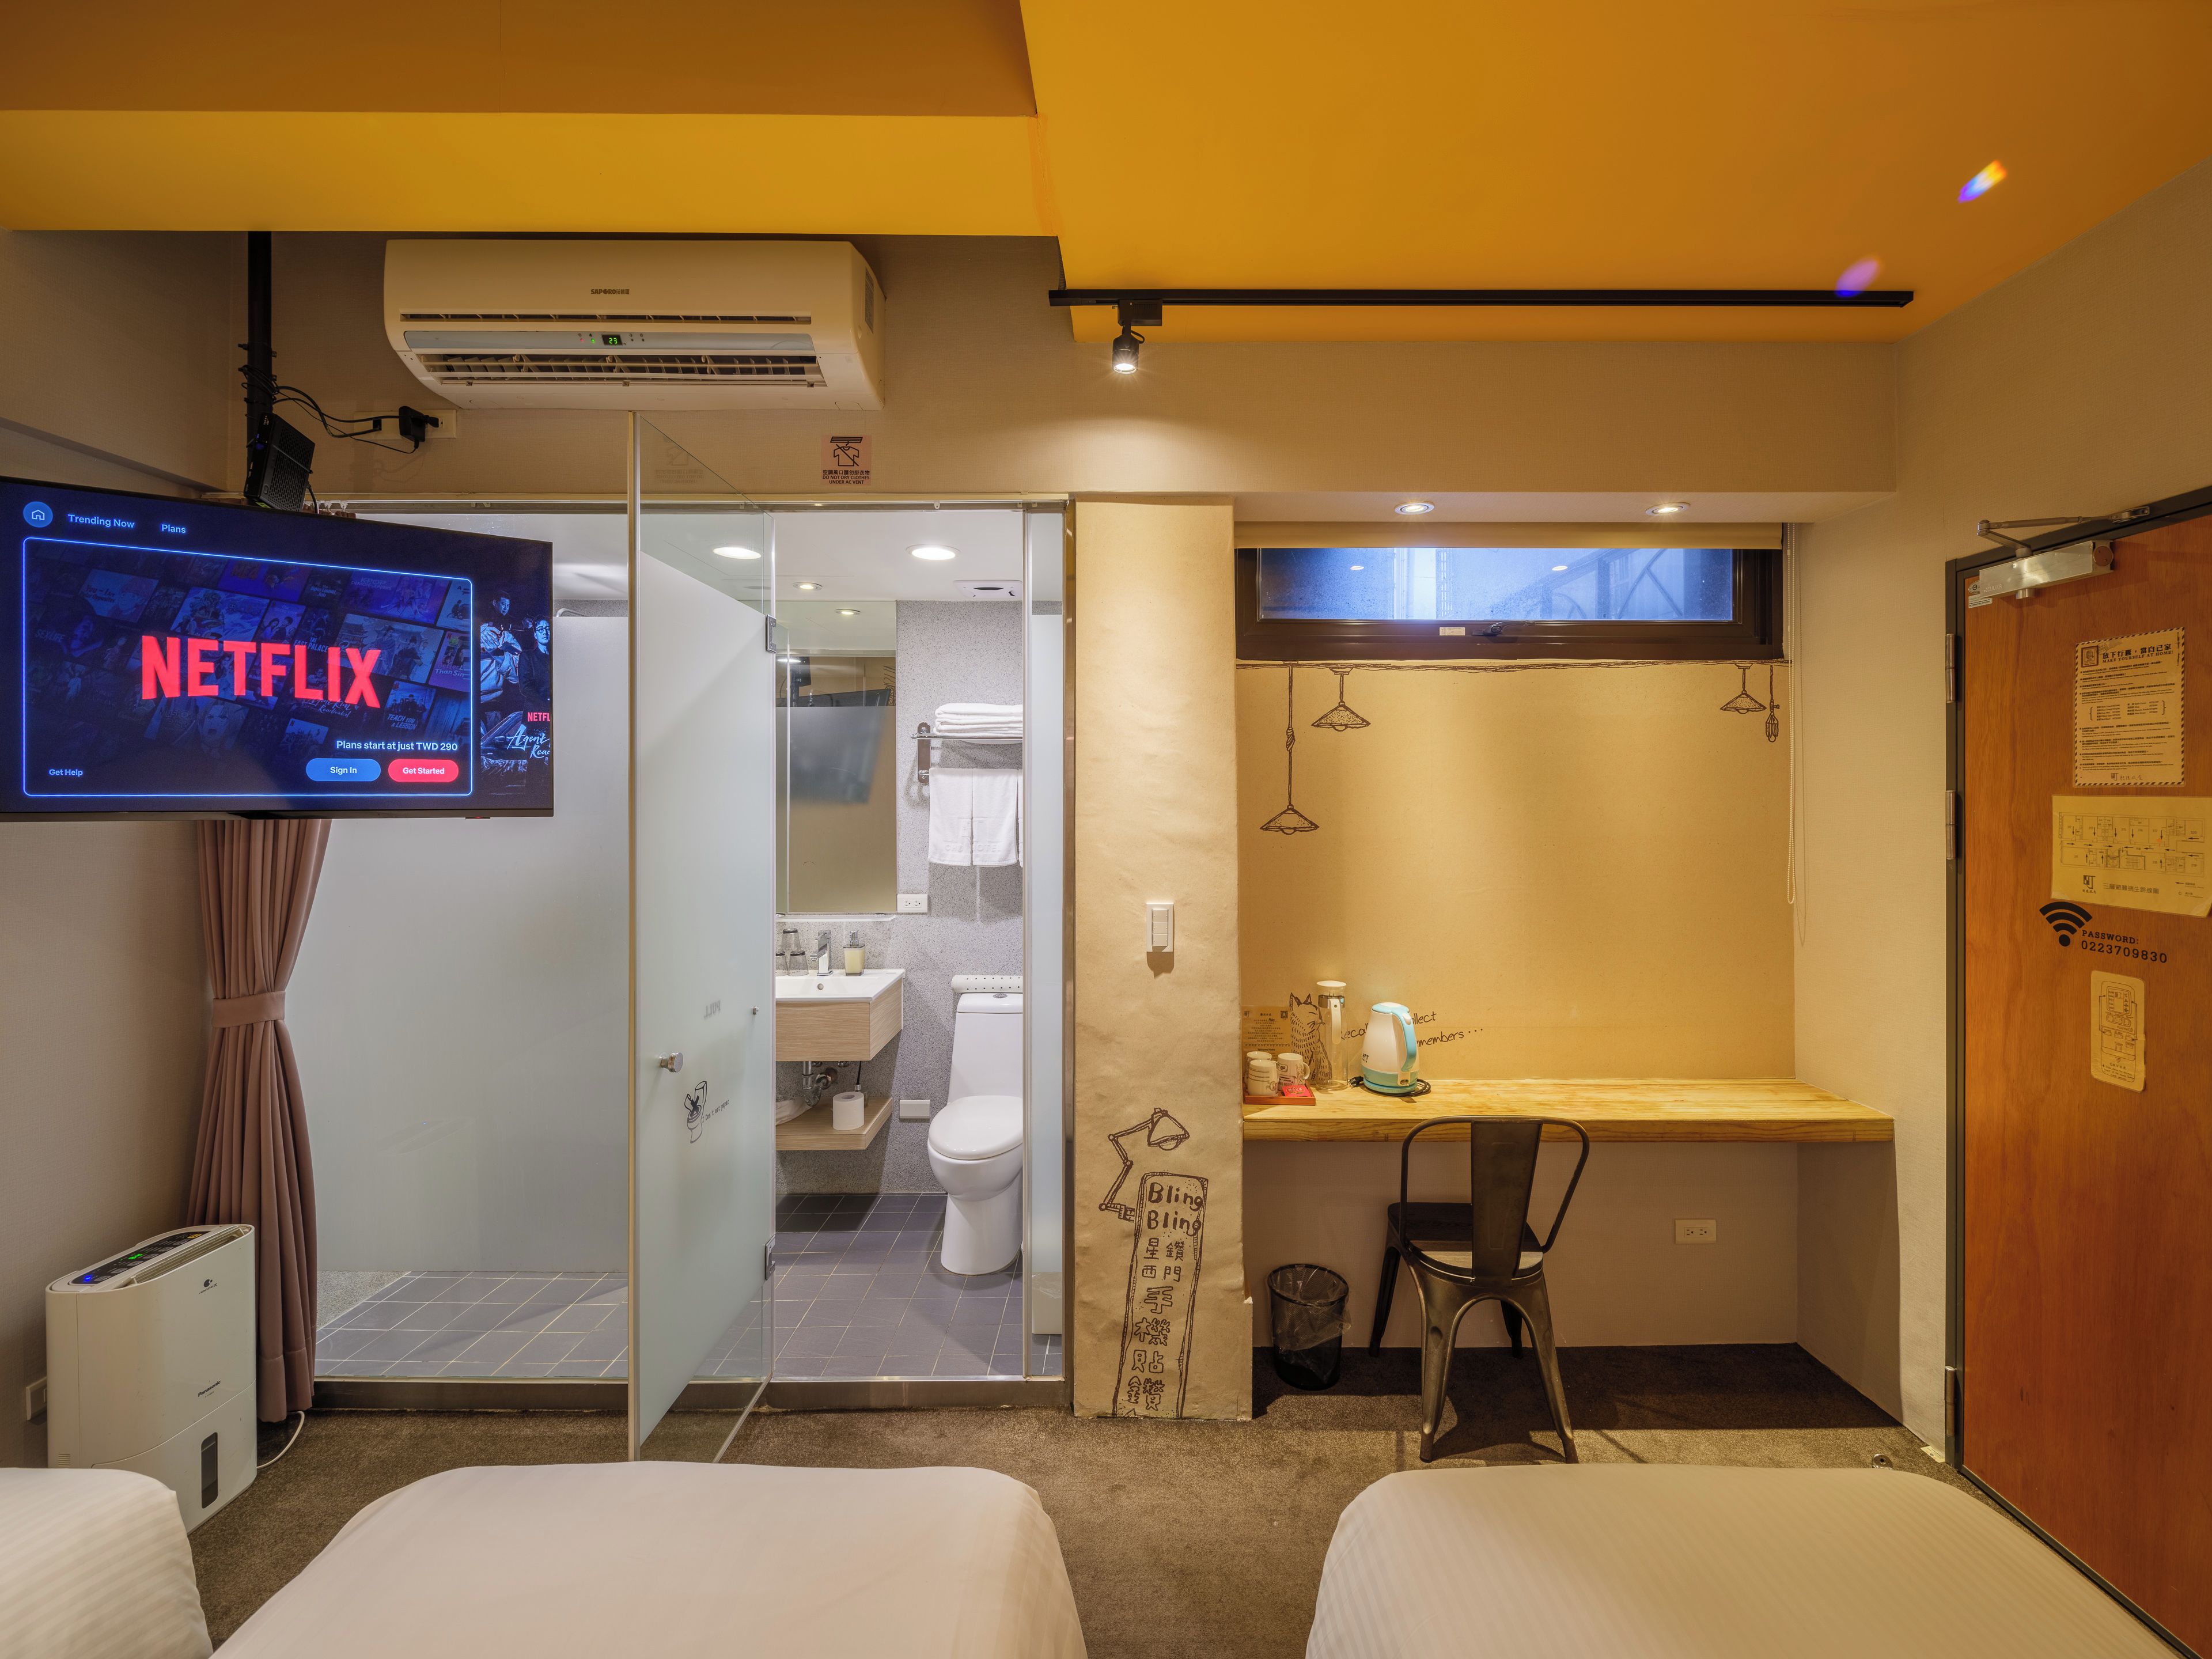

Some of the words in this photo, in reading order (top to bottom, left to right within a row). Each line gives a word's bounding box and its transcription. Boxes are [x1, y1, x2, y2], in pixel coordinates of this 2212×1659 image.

[68, 513, 112, 528] Trending
[113, 518, 135, 529] Now
[161, 523, 186, 534] Plans
[2103, 643, 2172, 659] 放下行囊，當自己家
[141, 634, 381, 709] NETFLIX
[507, 724, 550, 751] Agent
[336, 740, 362, 750] Plans
[363, 742, 385, 750] start
[396, 741, 414, 752] just
[416, 743, 438, 751] TWD
[440, 743, 458, 751] 290
[49, 768, 63, 776] Get
[65, 768, 84, 777] Help
[330, 766, 349, 775] Sign
[403, 767, 416, 775] Get
[418, 767, 445, 775] Started
[2081, 930, 2139, 945] PASSWORD:
[2081, 940, 2167, 963] 0223709830
[705, 1110, 714, 1122] Don't
[721, 1099, 729, 1112] paper
[1148, 1181, 1204, 1212] Bling
[1146, 1210, 1202, 1237] Bling
[198, 1380, 221, 1397] Panasonic
